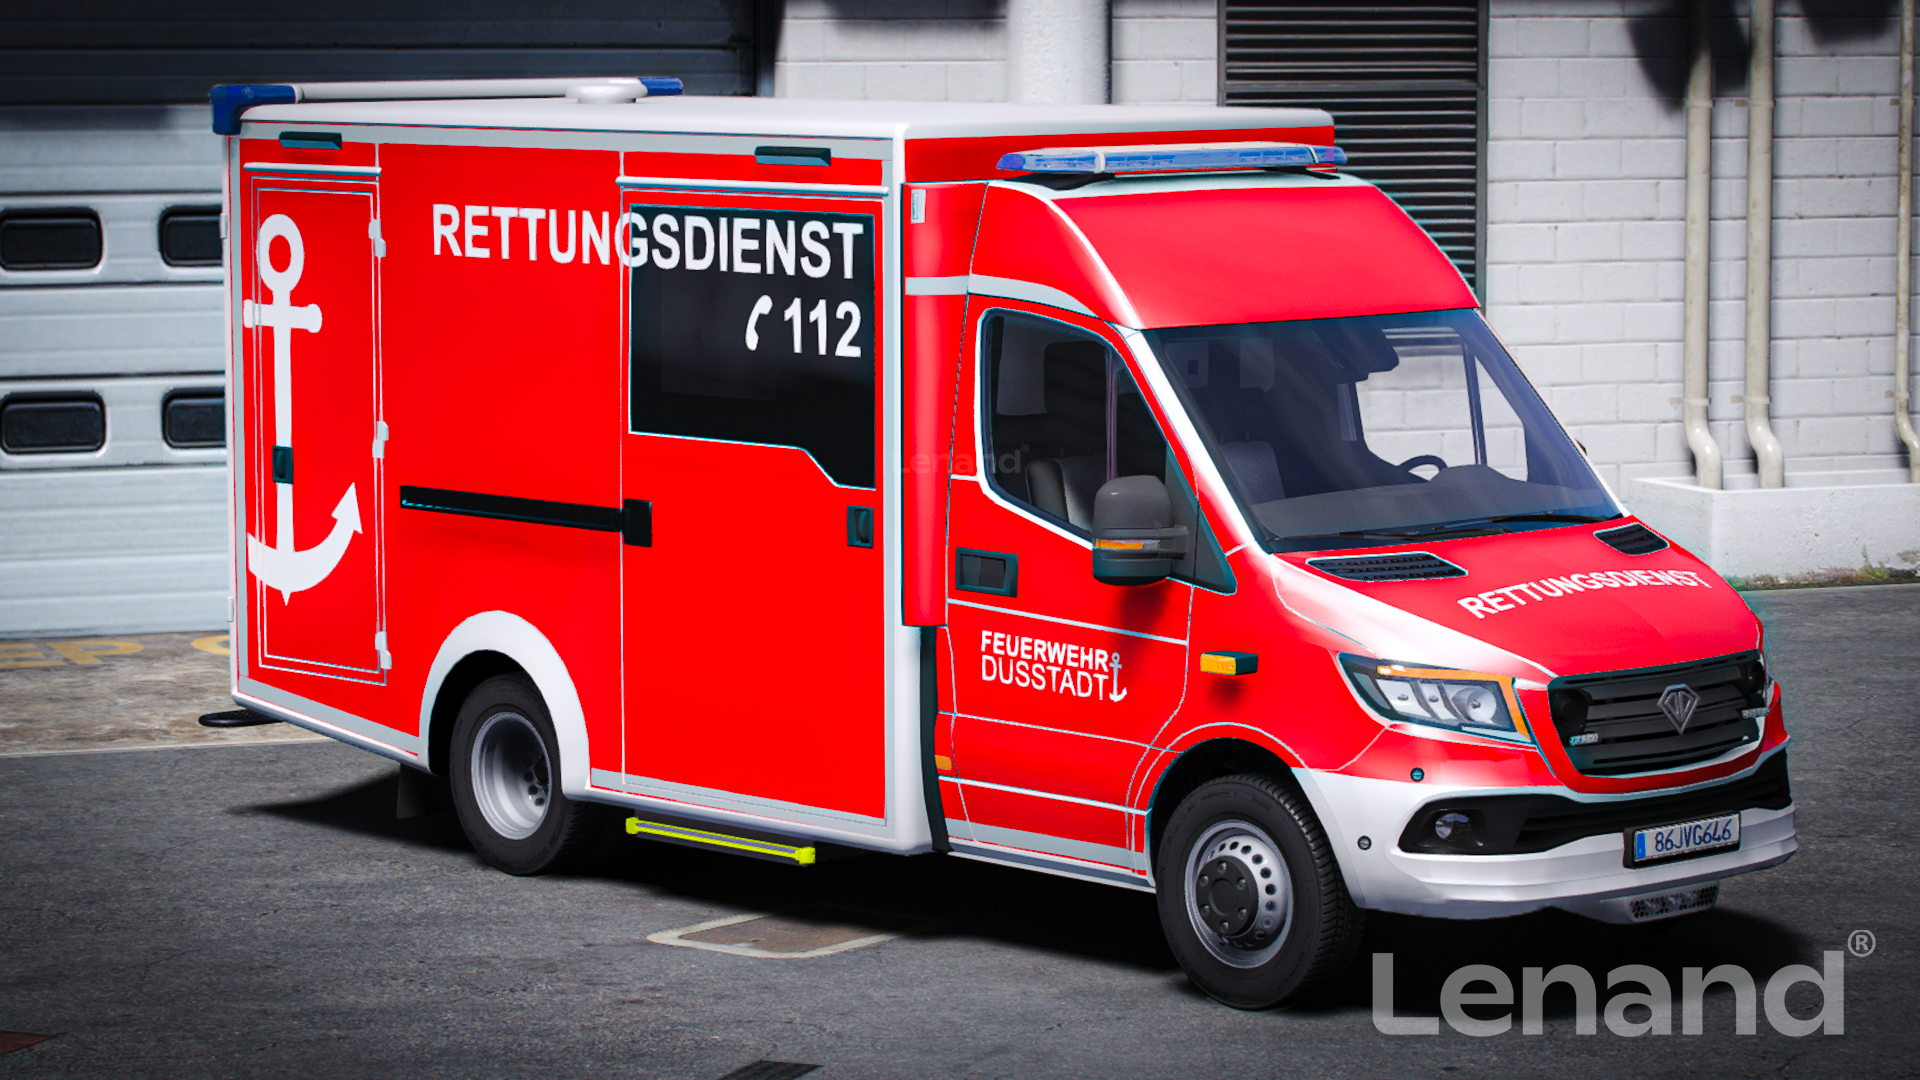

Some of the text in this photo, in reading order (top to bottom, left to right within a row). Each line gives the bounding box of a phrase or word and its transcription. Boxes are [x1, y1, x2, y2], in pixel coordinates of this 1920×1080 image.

[433, 204, 864, 279] RETTUNGSDIENST
[784, 297, 862, 358] 112
[1457, 569, 1713, 619] RETTUNGSDIENST
[981, 630, 1109, 672] FEUERWEHR
[982, 655, 1109, 700] DUSSTADT
[1655, 819, 1732, 852] 86JVG646
